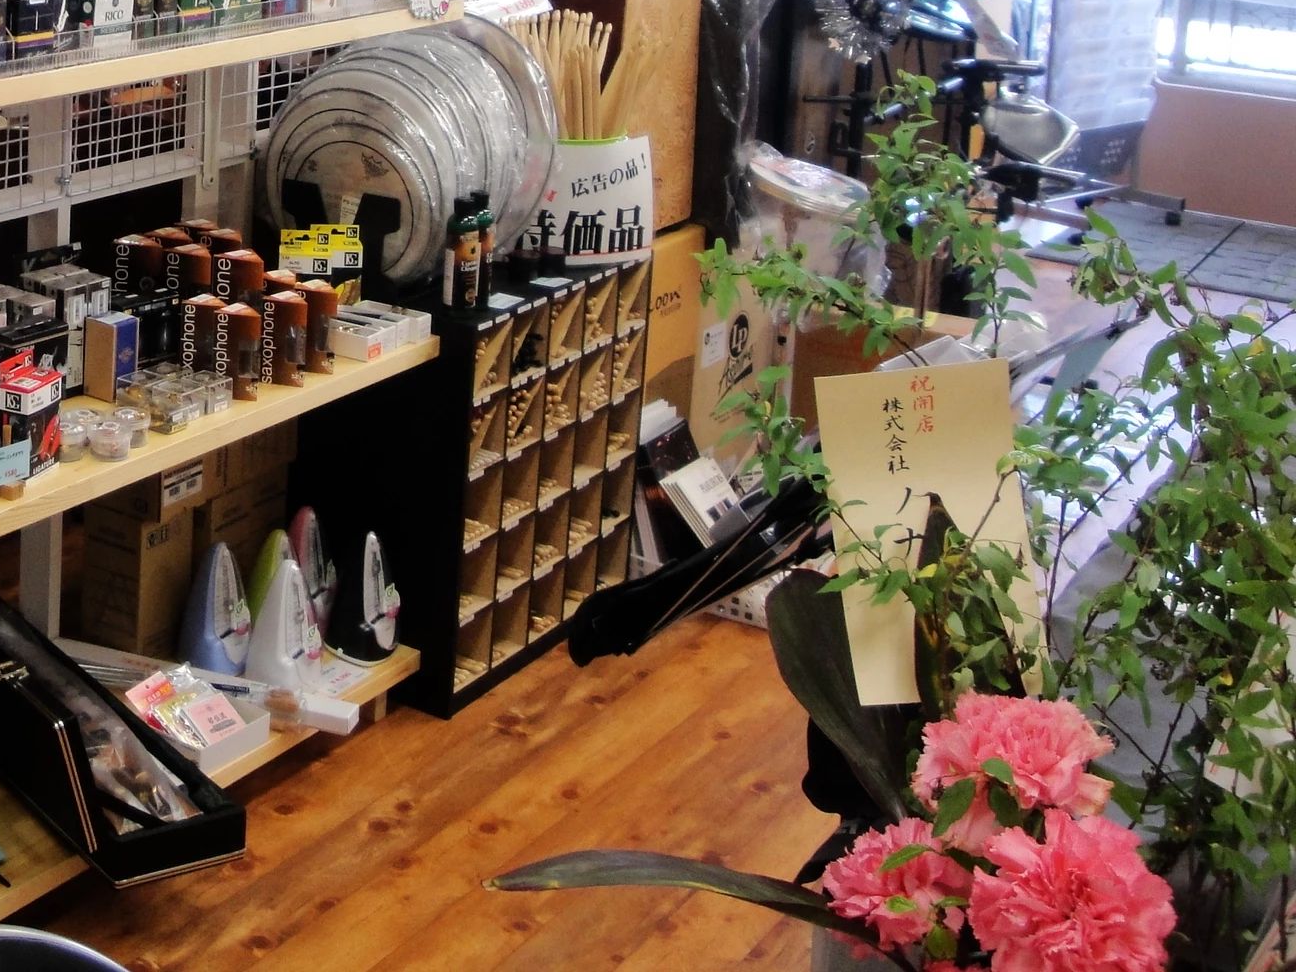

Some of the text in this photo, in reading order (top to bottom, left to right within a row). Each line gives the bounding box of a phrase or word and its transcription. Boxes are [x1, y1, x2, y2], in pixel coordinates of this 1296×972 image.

[105, 10, 125, 22] RICO
[261, 301, 276, 384] saxophone
[909, 375, 936, 434] 祝開店
[881, 396, 910, 475] 株式会社
[32, 459, 55, 475] LIGATURE
